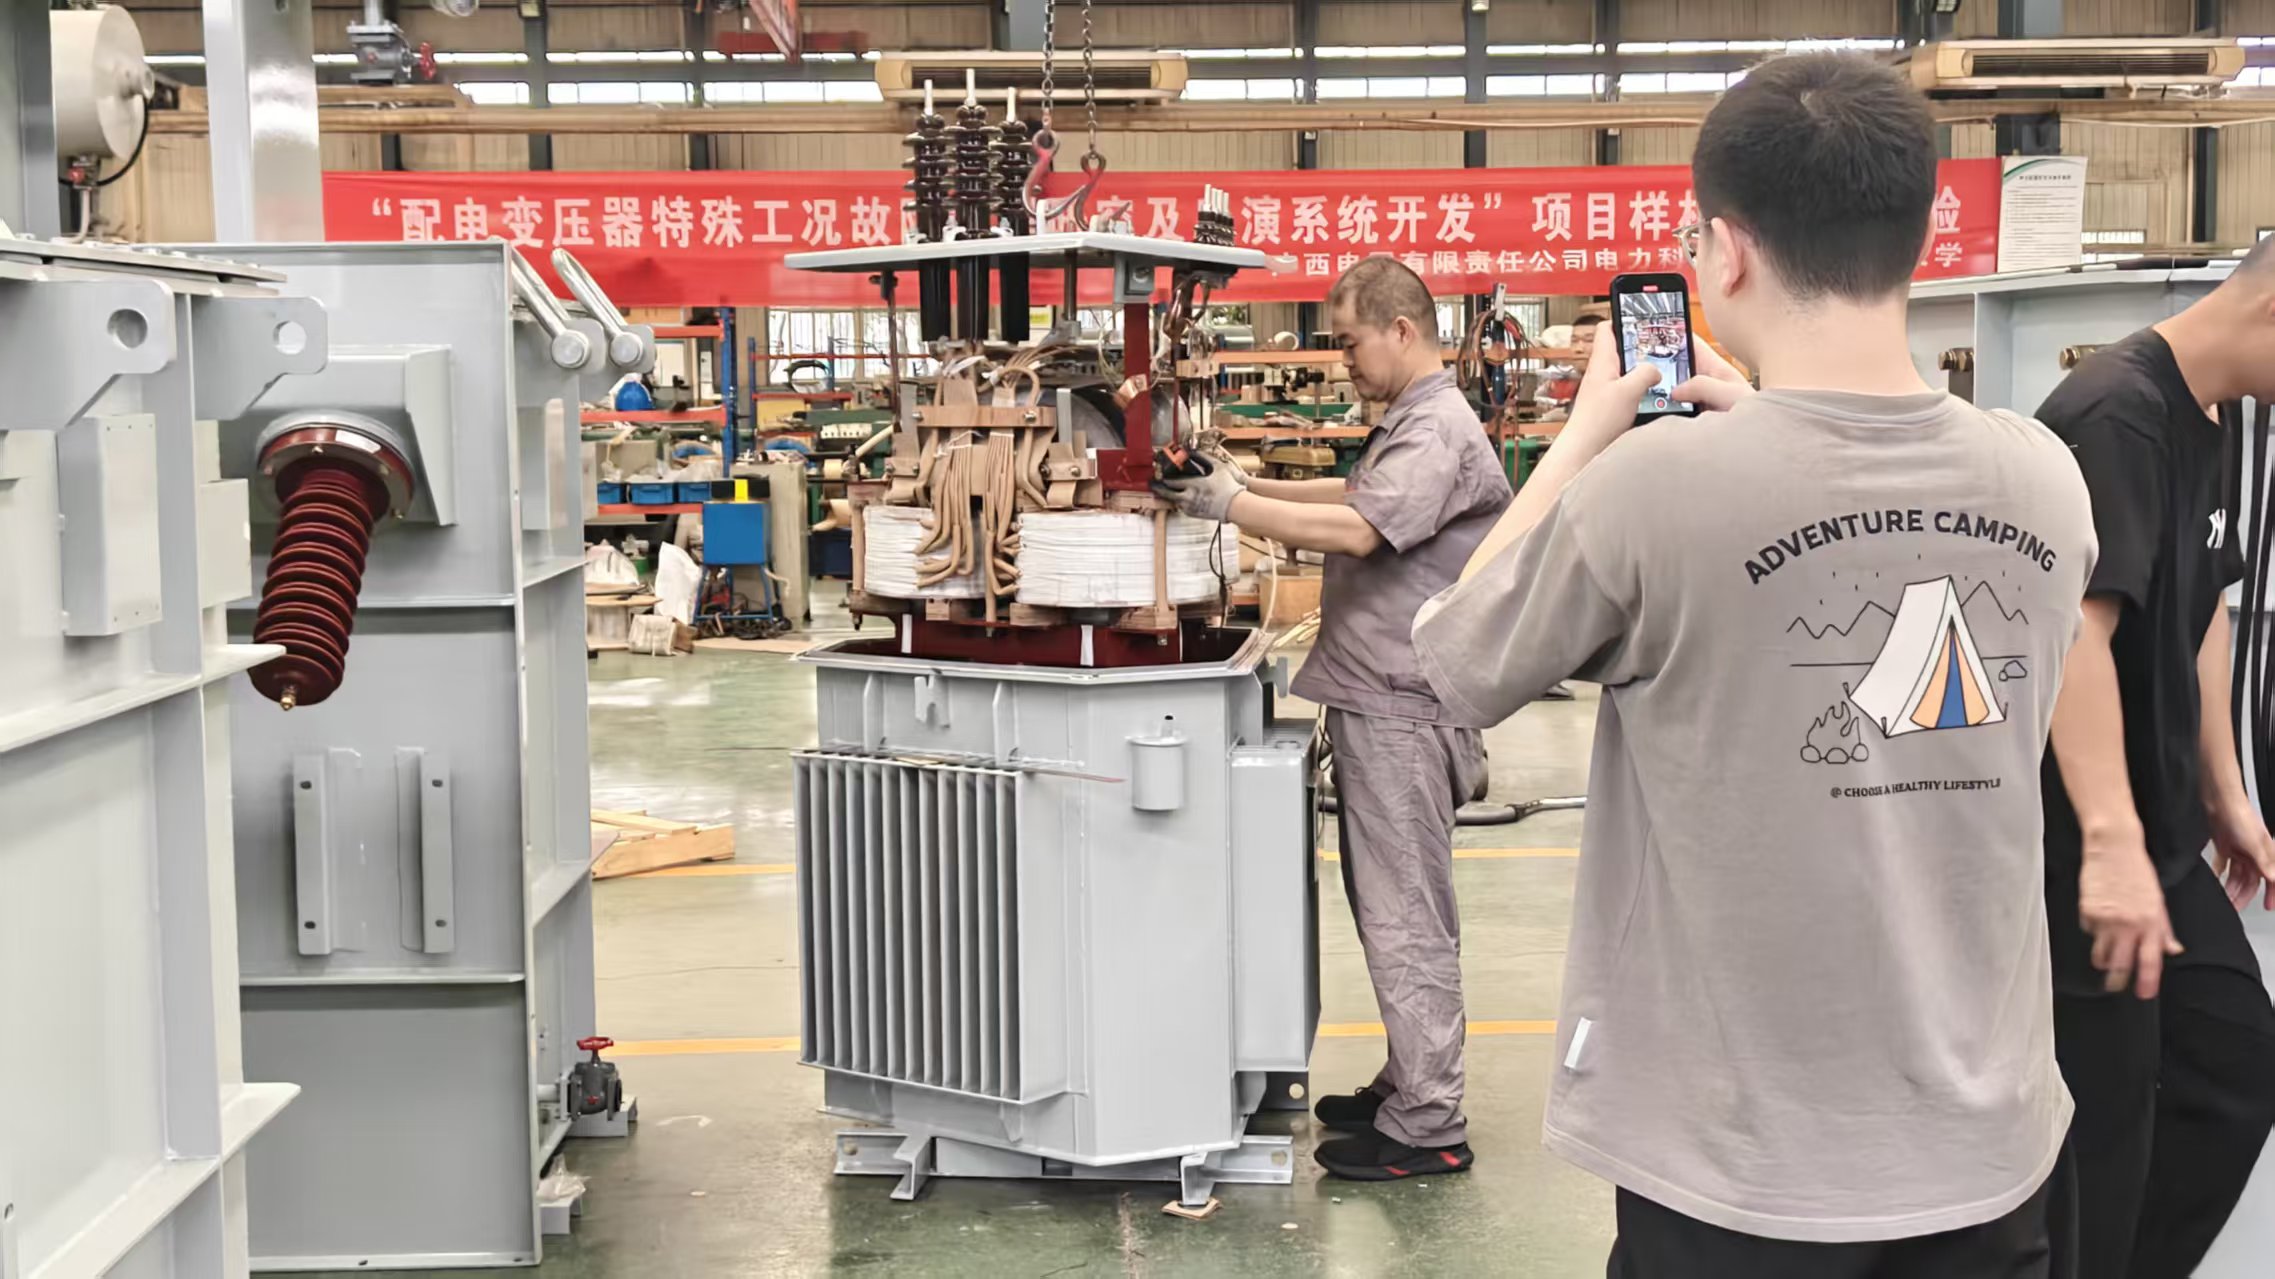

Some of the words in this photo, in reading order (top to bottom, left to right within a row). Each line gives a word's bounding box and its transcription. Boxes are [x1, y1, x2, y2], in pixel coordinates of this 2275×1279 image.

[1272, 249, 1684, 276] 西电有限责任公司电力科
[1744, 509, 1924, 584] ADVENTURE
[1934, 511, 2057, 572] CAMPING
[1892, 781, 1943, 794] HEALTHY
[1944, 778, 2001, 791] LIFESTYLE
